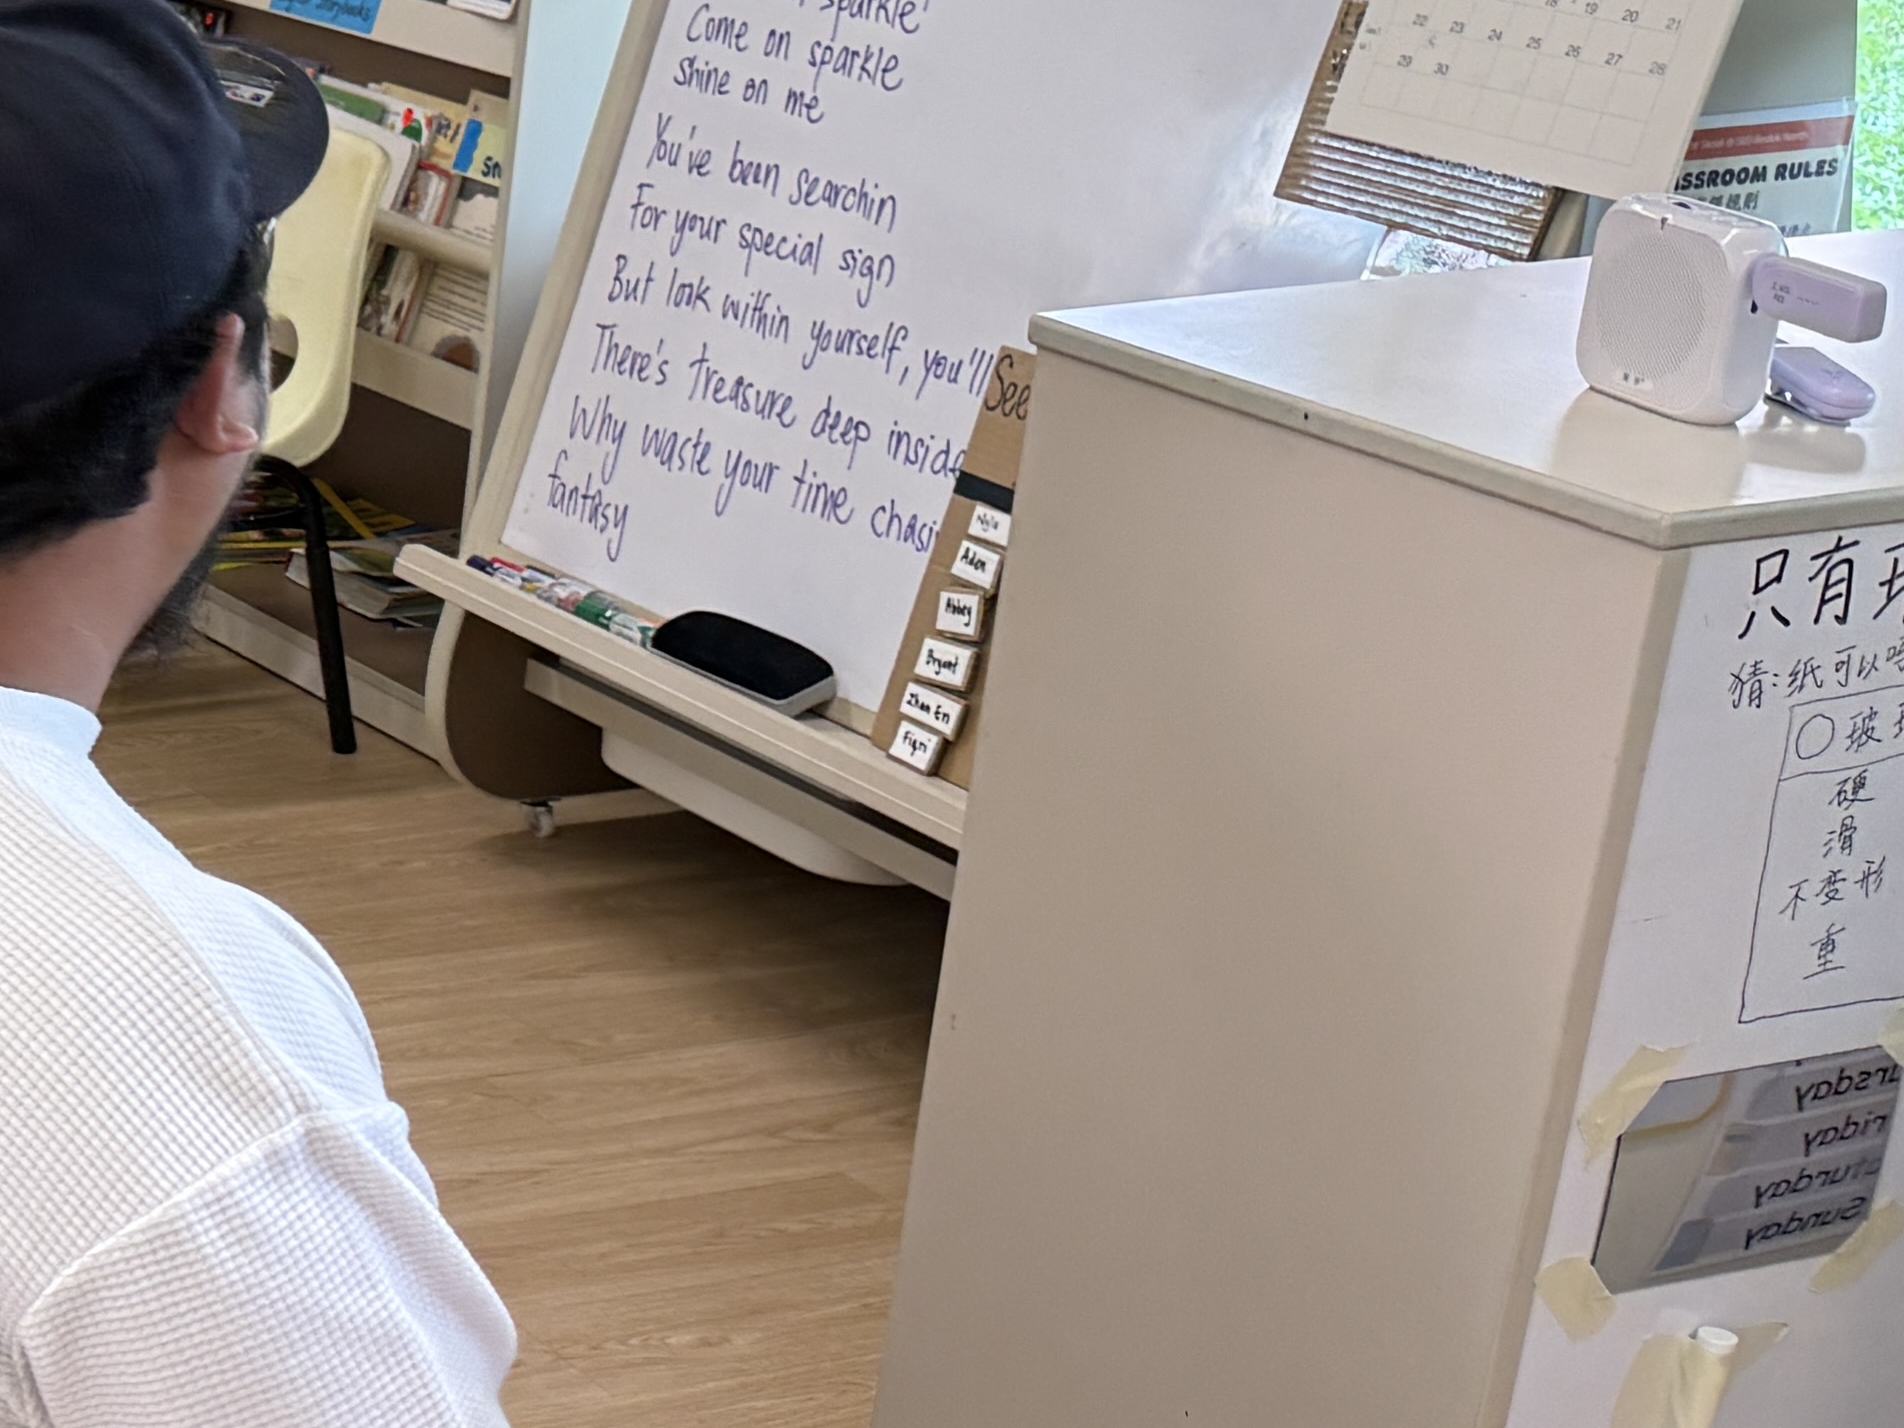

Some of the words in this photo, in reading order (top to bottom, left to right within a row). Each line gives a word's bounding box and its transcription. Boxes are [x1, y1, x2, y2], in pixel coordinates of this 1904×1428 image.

[685, 3, 749, 53] Come
[763, 29, 791, 61] on
[808, 39, 904, 92] sparkle
[742, 77, 768, 105] on
[784, 88, 825, 124] me
[646, 112, 712, 177] You've
[728, 140, 781, 197] been
[1774, 158, 1838, 182] RULES
[629, 182, 666, 232] For
[669, 207, 727, 258] your
[739, 222, 823, 276] special
[838, 247, 895, 308] sign
[608, 253, 655, 305] But
[666, 267, 711, 313] look
[721, 292, 790, 344] within
[801, 319, 910, 387] yourself,
[915, 347, 993, 401] you'll
[591, 322, 670, 387] There's
[688, 342, 796, 429] treasure
[810, 396, 871, 469] deep
[984, 354, 1031, 420] See
[568, 394, 628, 485] Why
[640, 422, 711, 478] waste
[715, 448, 781, 516] your
[793, 459, 855, 526] time
[934, 704, 950, 724] En
[1828, 768, 1875, 811] 硬
[1822, 814, 1857, 859] 滑
[1779, 855, 1886, 921] 不变形
[1802, 922, 1846, 980] 重
